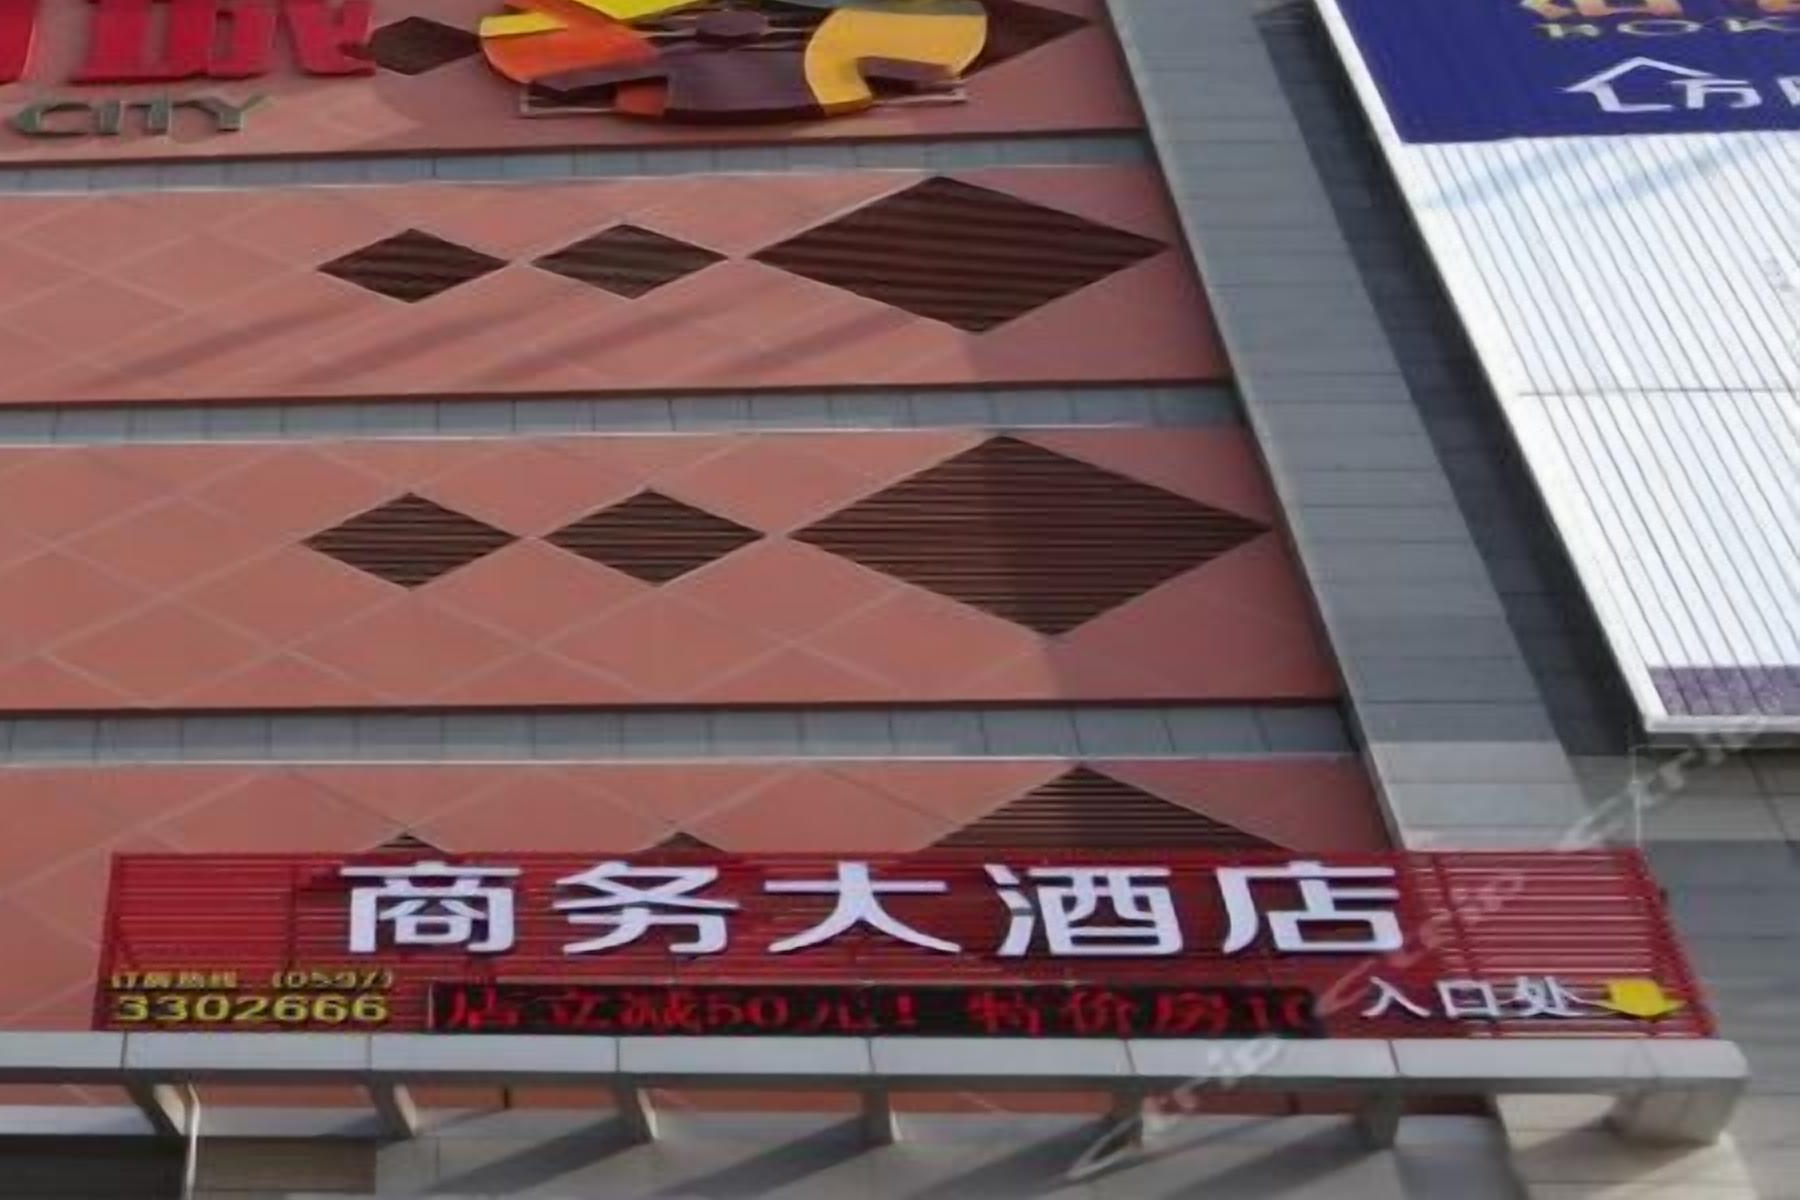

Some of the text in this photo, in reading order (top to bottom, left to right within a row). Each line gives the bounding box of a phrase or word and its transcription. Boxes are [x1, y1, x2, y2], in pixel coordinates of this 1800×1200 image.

[11, 93, 272, 137] CITY
[340, 857, 1405, 961] 商务大酒店
[114, 994, 388, 1023] 3302666
[1361, 974, 1602, 1020] 入口处
